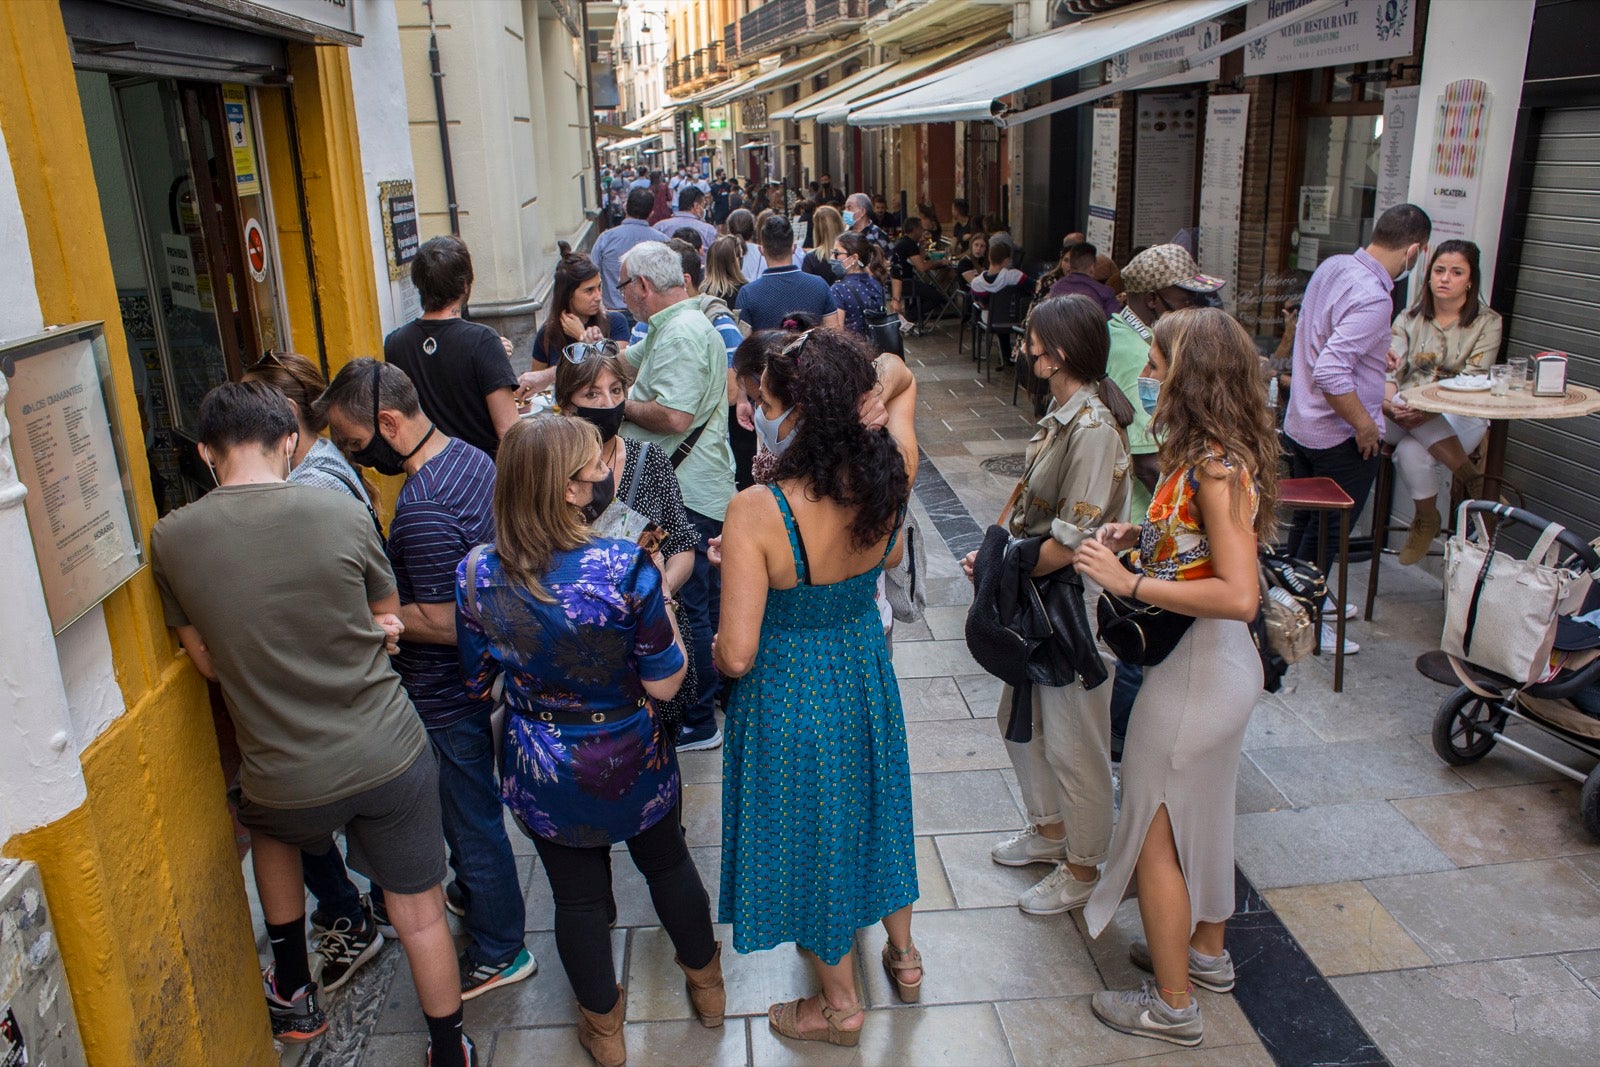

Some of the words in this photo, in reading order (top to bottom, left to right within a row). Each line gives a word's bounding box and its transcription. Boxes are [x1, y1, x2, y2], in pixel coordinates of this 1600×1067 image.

[1268, 0, 1314, 19] Herma
[1281, 23, 1302, 37] NUEVO
[1304, 11, 1358, 34] RESTAURANTE
[1317, 43, 1360, 57] RESTAURANTE
[31, 399, 46, 412] LOS
[46, 384, 84, 406] DIAMANTES
[93, 521, 115, 541] HORARIO
